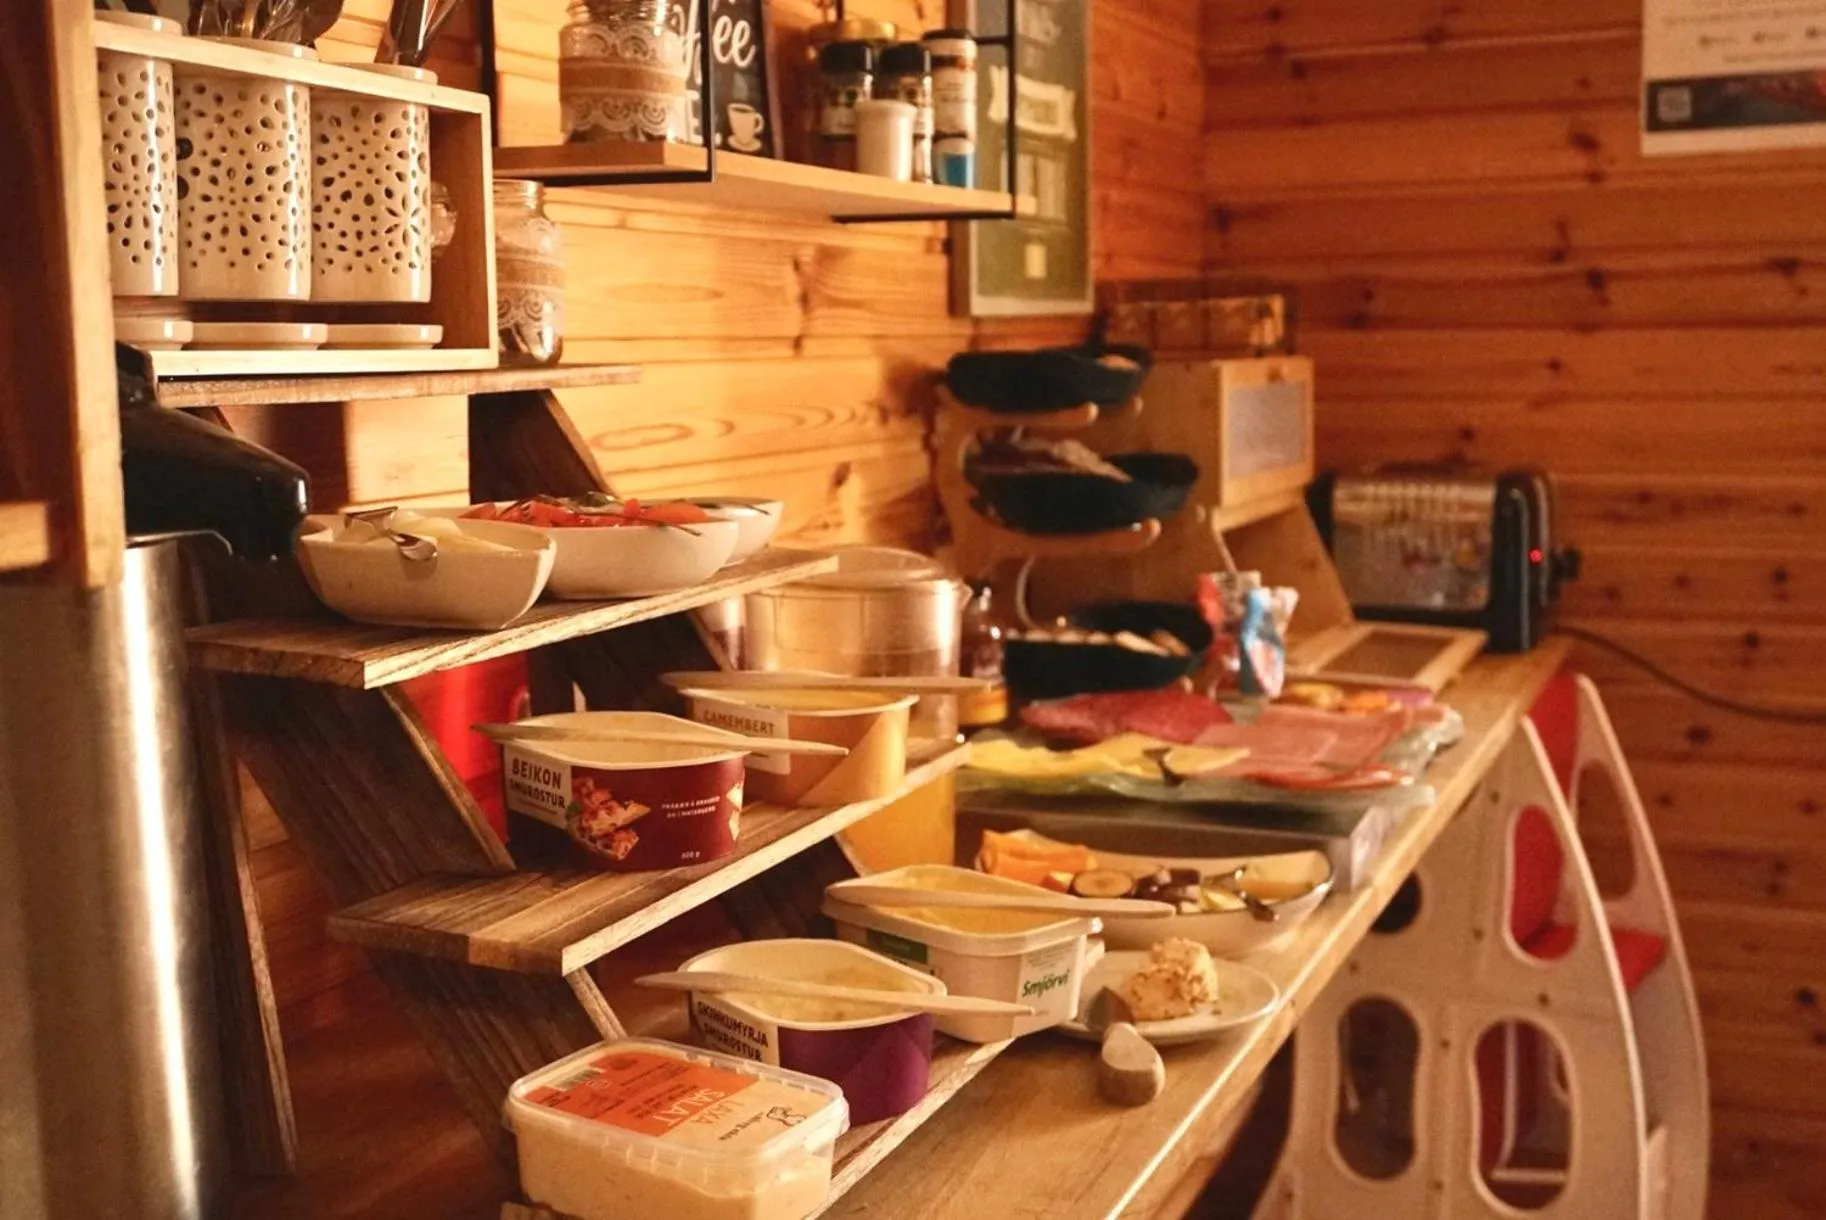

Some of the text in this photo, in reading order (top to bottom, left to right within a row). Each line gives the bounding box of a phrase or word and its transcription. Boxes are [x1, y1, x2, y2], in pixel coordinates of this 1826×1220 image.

[703, 709, 775, 736] CAMEMBERT
[512, 757, 561, 790] BEIKON
[1021, 967, 1070, 999] Smjörvi
[652, 1088, 725, 1127] SALAT
